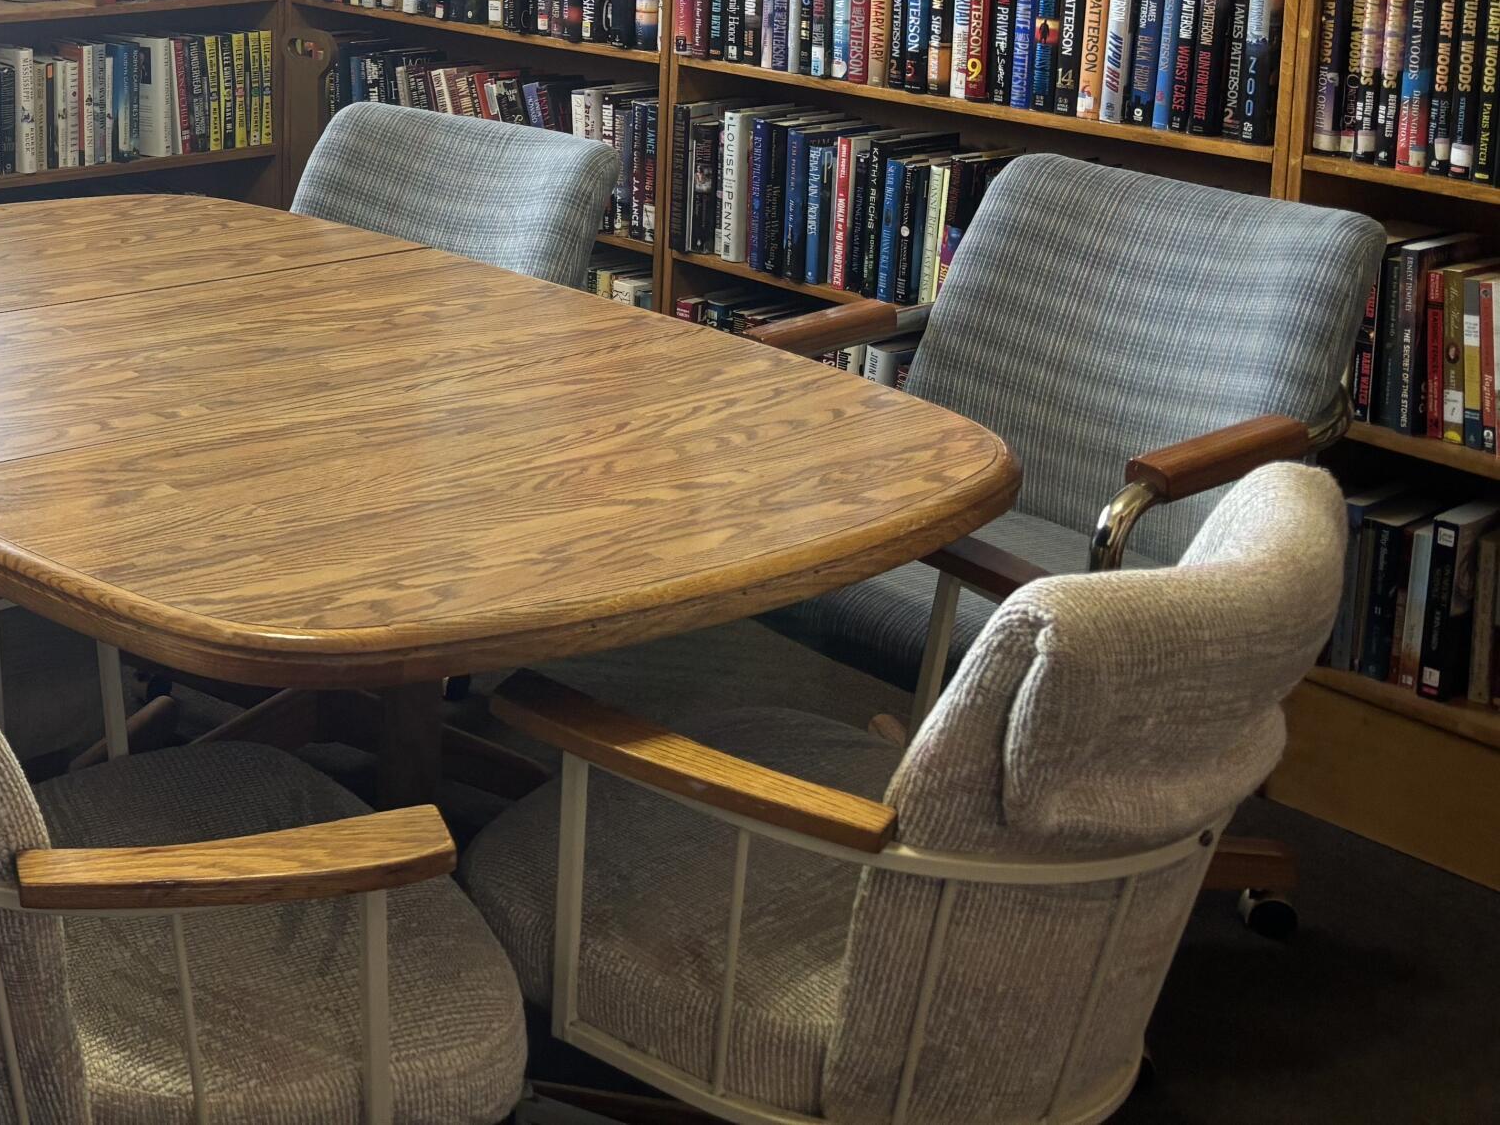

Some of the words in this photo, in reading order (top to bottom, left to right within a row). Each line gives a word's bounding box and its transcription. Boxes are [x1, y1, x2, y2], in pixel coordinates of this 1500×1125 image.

[871, 0, 885, 29] MARY
[1148, 1, 1157, 22] JAMES
[1179, 0, 1194, 38] PATTERSON
[728, 17, 740, 43] Honor
[870, 33, 884, 62] MARY
[1107, 32, 1124, 66] NYPD
[1137, 35, 1154, 61] BLACK
[1407, 34, 1422, 80] WOODS
[1133, 64, 1150, 92] FRIDAY
[1174, 46, 1190, 82] WORST
[1482, 45, 1498, 93] WOODS
[1105, 70, 1120, 93] RED
[1245, 57, 1258, 116] ZOO
[1171, 85, 1186, 111] CASE
[1481, 103, 1492, 128] PARIS
[724, 124, 737, 175] LOUISE
[1478, 132, 1490, 165] MATCH
[869, 147, 880, 184] KATHY
[722, 189, 734, 241] PENNY
[867, 188, 878, 229] REICHS
[832, 242, 843, 285] IMPORTANCE
[1403, 329, 1411, 342] THE
[1402, 345, 1410, 371] SECRET
[1402, 373, 1409, 383] OF
[1484, 375, 1492, 413] Ragtime
[1400, 399, 1409, 427] STONES
